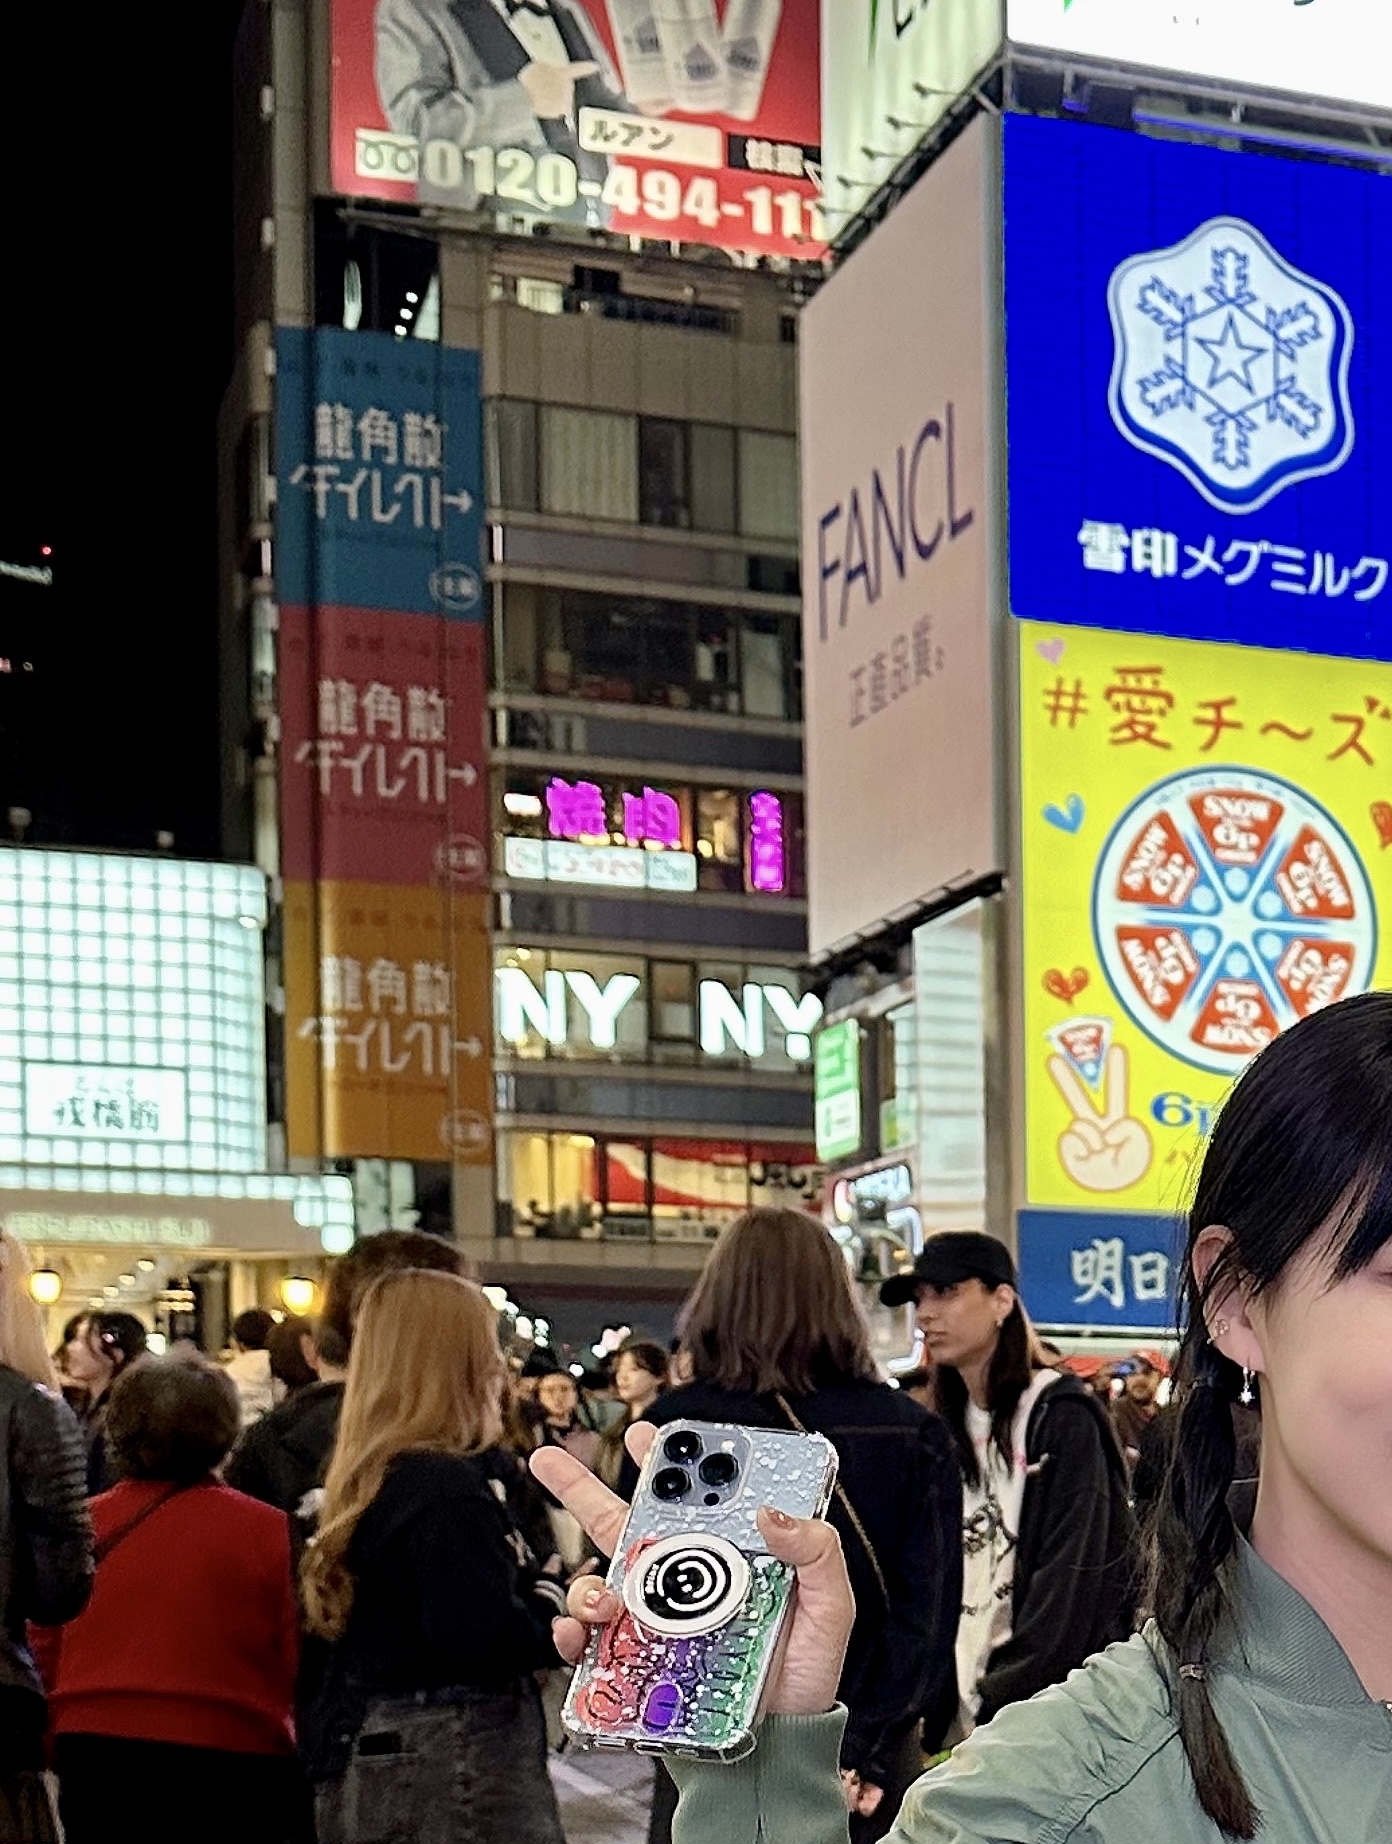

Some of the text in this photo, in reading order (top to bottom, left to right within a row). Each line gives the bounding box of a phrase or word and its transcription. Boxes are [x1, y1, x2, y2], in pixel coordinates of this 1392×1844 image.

[590, 119, 675, 151] ルアン
[314, 402, 448, 469] 龍角散
[818, 402, 974, 642] FANCL
[1077, 519, 1389, 601] 雪印メグミルク
[317, 676, 451, 743] 龍角散
[320, 953, 457, 1017] 龍角散
[497, 966, 641, 1049] NY
[700, 977, 825, 1061] NY
[1071, 1237, 1169, 1309] 明日
